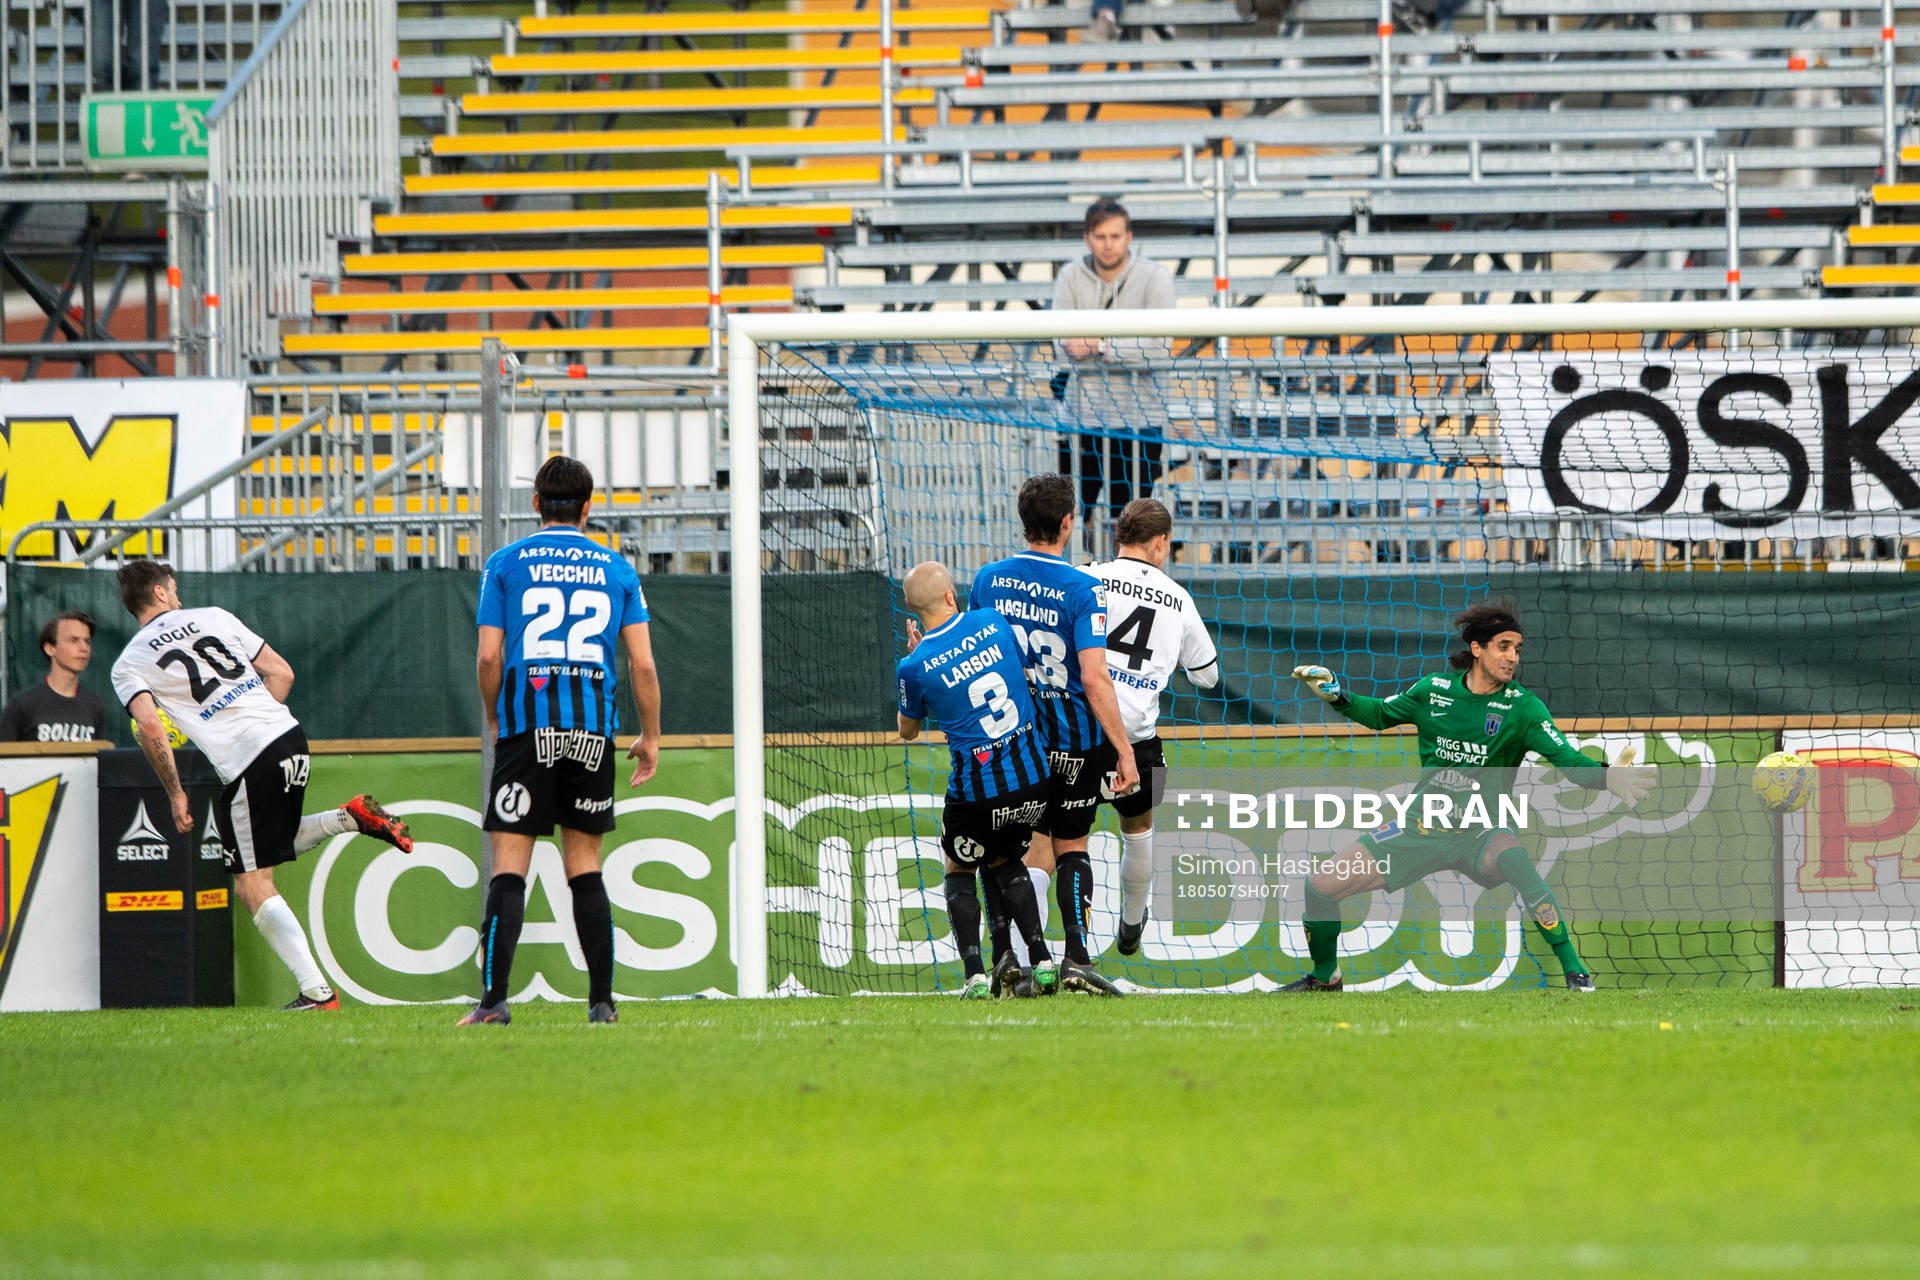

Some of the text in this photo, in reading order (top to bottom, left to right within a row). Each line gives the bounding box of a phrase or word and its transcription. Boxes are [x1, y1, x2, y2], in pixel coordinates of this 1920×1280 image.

[1541, 364, 1920, 528] ÖSK
[0, 413, 178, 561] M
[518, 547, 612, 563] ÅRSTA TAK
[529, 564, 607, 586] VECCHIA
[991, 575, 1066, 601] ÅRSTA TAK
[994, 599, 1059, 627] HAGLUND
[1101, 578, 1183, 613] BRORSSON
[148, 621, 201, 652] ROGIC
[521, 587, 611, 665] 22
[1106, 605, 1157, 671] 4
[923, 623, 999, 673] ÅRSTA TAK
[155, 635, 246, 706] 20
[940, 643, 1003, 689] LARSON
[968, 671, 1019, 739] 3
[1435, 747, 1488, 767] CONSTRUCT
[1436, 735, 1460, 751] BYGG
[1796, 747, 1920, 893] P
[117, 844, 170, 861] SELECT
[119, 895, 171, 908] DHL
